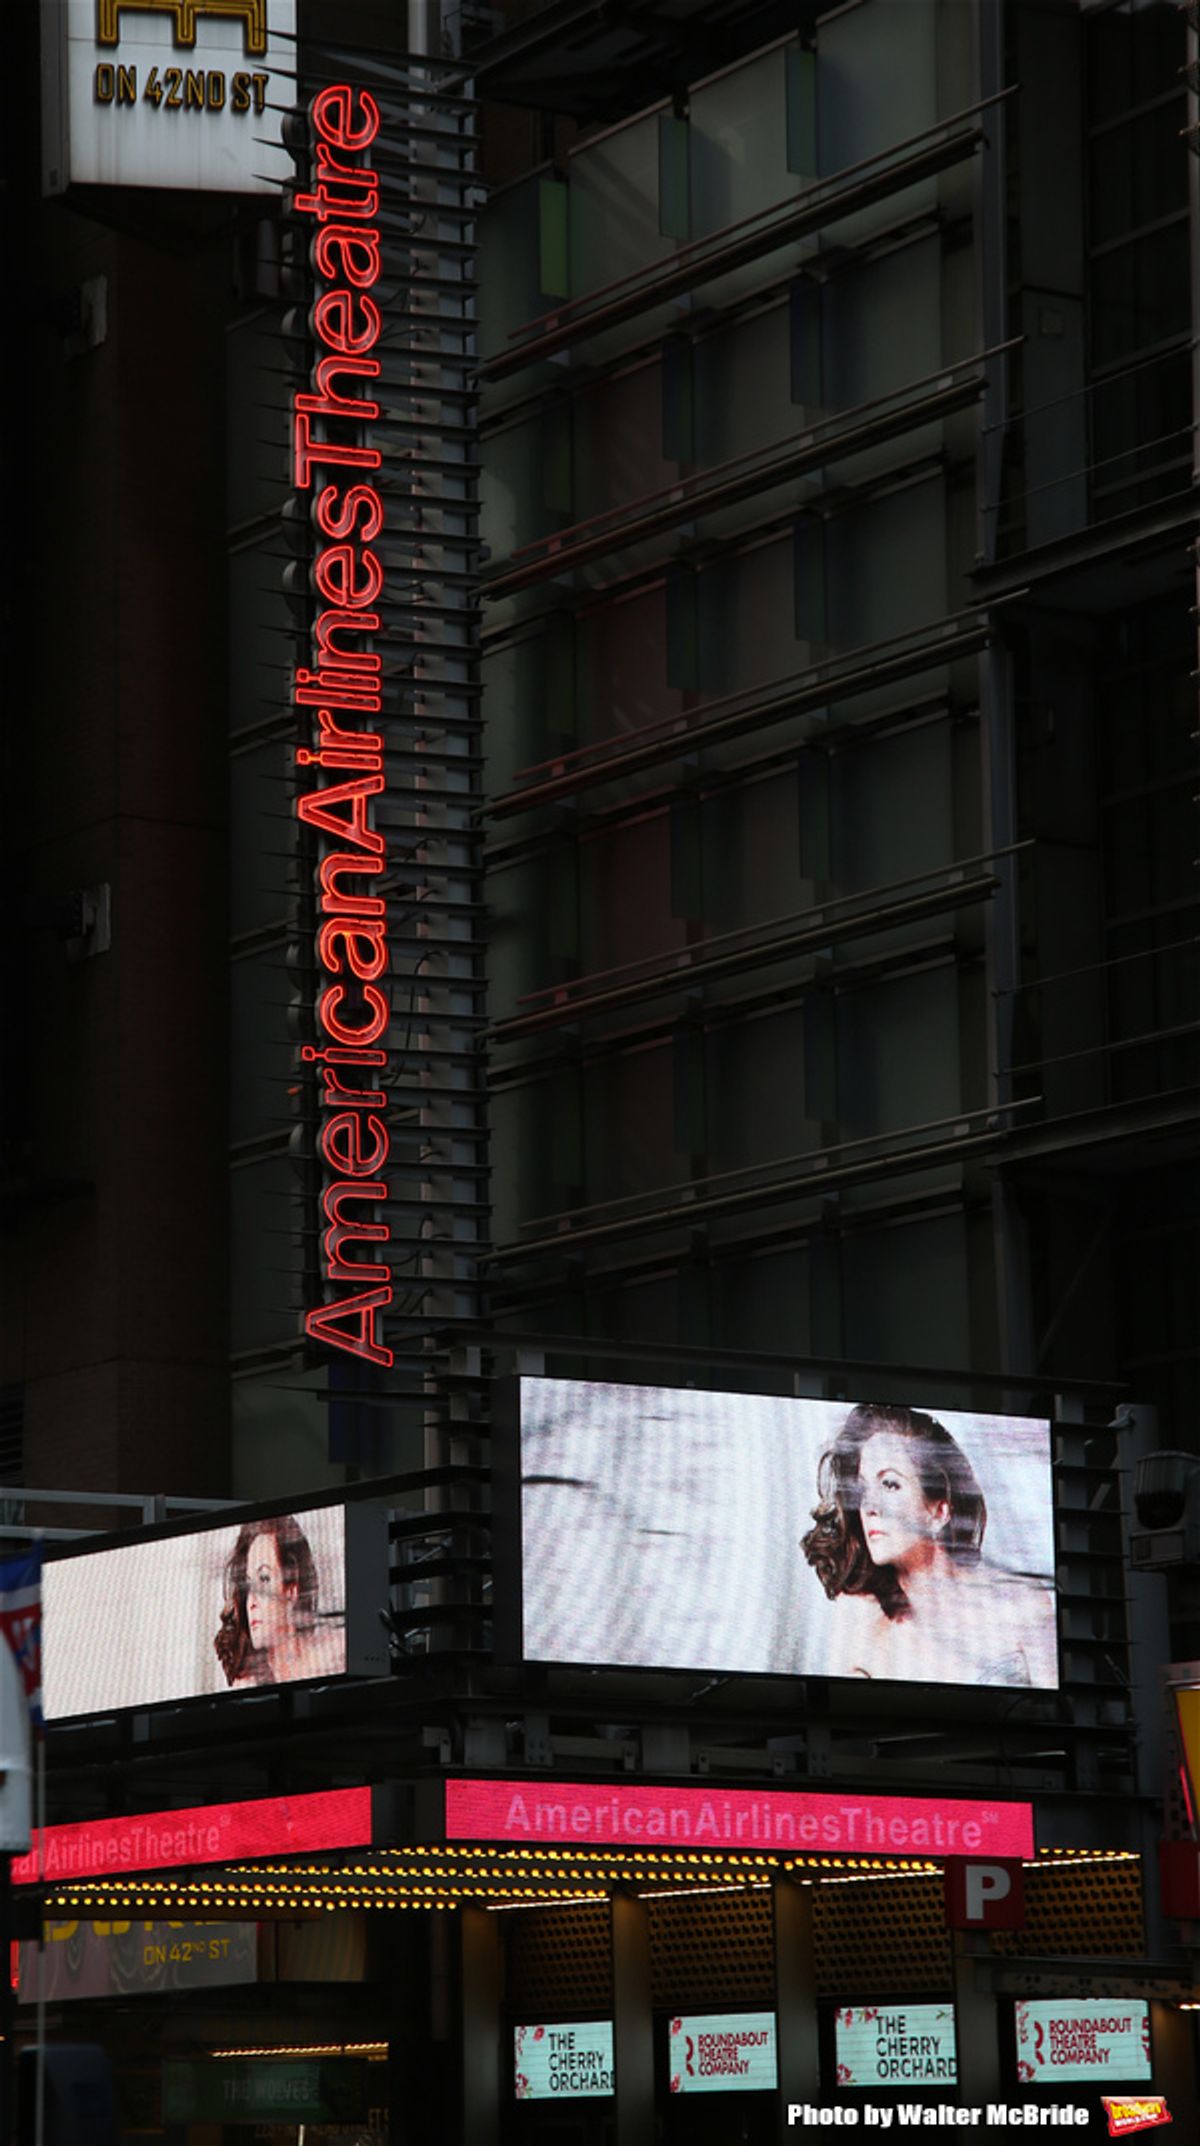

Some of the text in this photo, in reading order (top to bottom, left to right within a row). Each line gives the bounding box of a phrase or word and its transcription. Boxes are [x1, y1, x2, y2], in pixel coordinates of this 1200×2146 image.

[95, 63, 269, 114] ON 42ND ST
[293, 83, 393, 1369] AmericanAirlinesTheatre
[966, 1865, 1011, 1919] P
[144, 1944, 166, 1966] ON
[208, 1938, 231, 1959] ST
[875, 2015, 906, 2035] THE
[1049, 2017, 1131, 2035] ROUNDABOUT
[548, 2031, 575, 2051] THE
[698, 2031, 768, 2048] ROUNDABOUT
[876, 2036, 940, 2057] CHERRY
[1049, 2033, 1096, 2049] THEATRE
[549, 2051, 604, 2071] CHERRY
[698, 2046, 738, 2062] THEATRE
[1050, 2048, 1110, 2065] COMPANY
[698, 2060, 749, 2076] COMPANY
